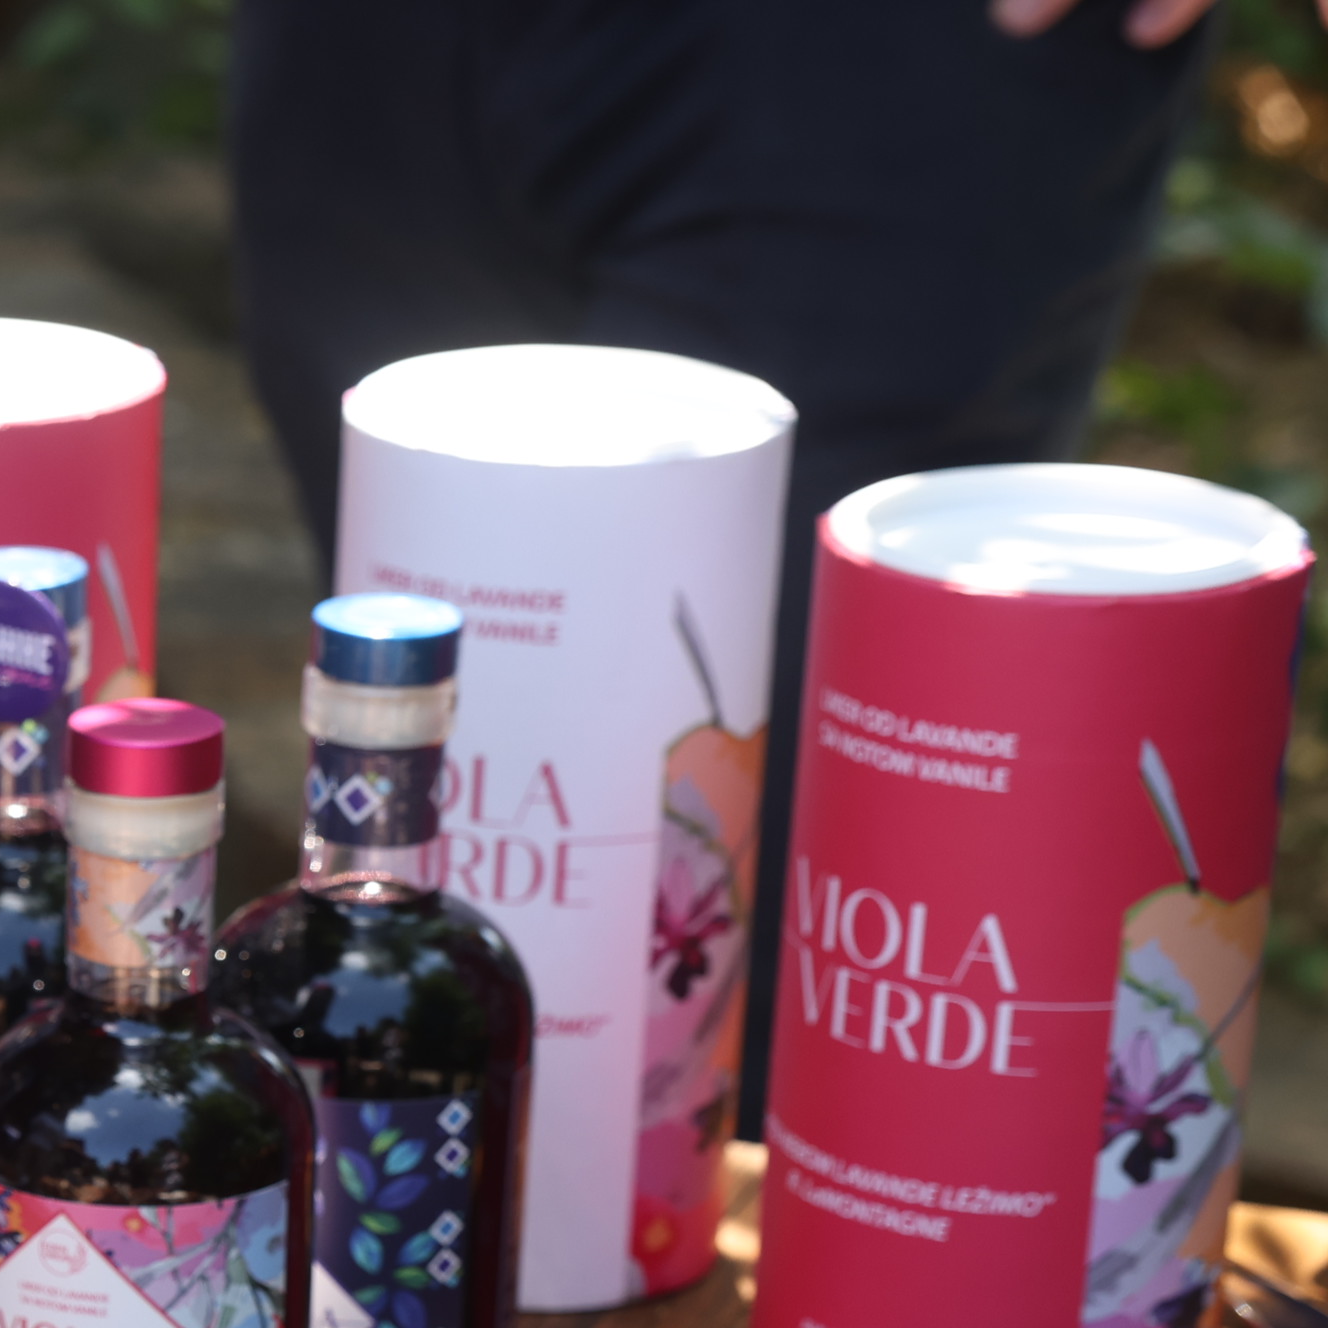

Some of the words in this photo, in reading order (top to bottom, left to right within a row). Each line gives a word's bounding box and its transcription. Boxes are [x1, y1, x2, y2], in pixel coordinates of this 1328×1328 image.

[897, 716, 1021, 760] LAVANDE
[917, 757, 1012, 793] VANILE
[796, 854, 1019, 994] VIOLA
[798, 946, 1040, 1078] VERDE
[834, 1157, 941, 1209] LAVANDE
